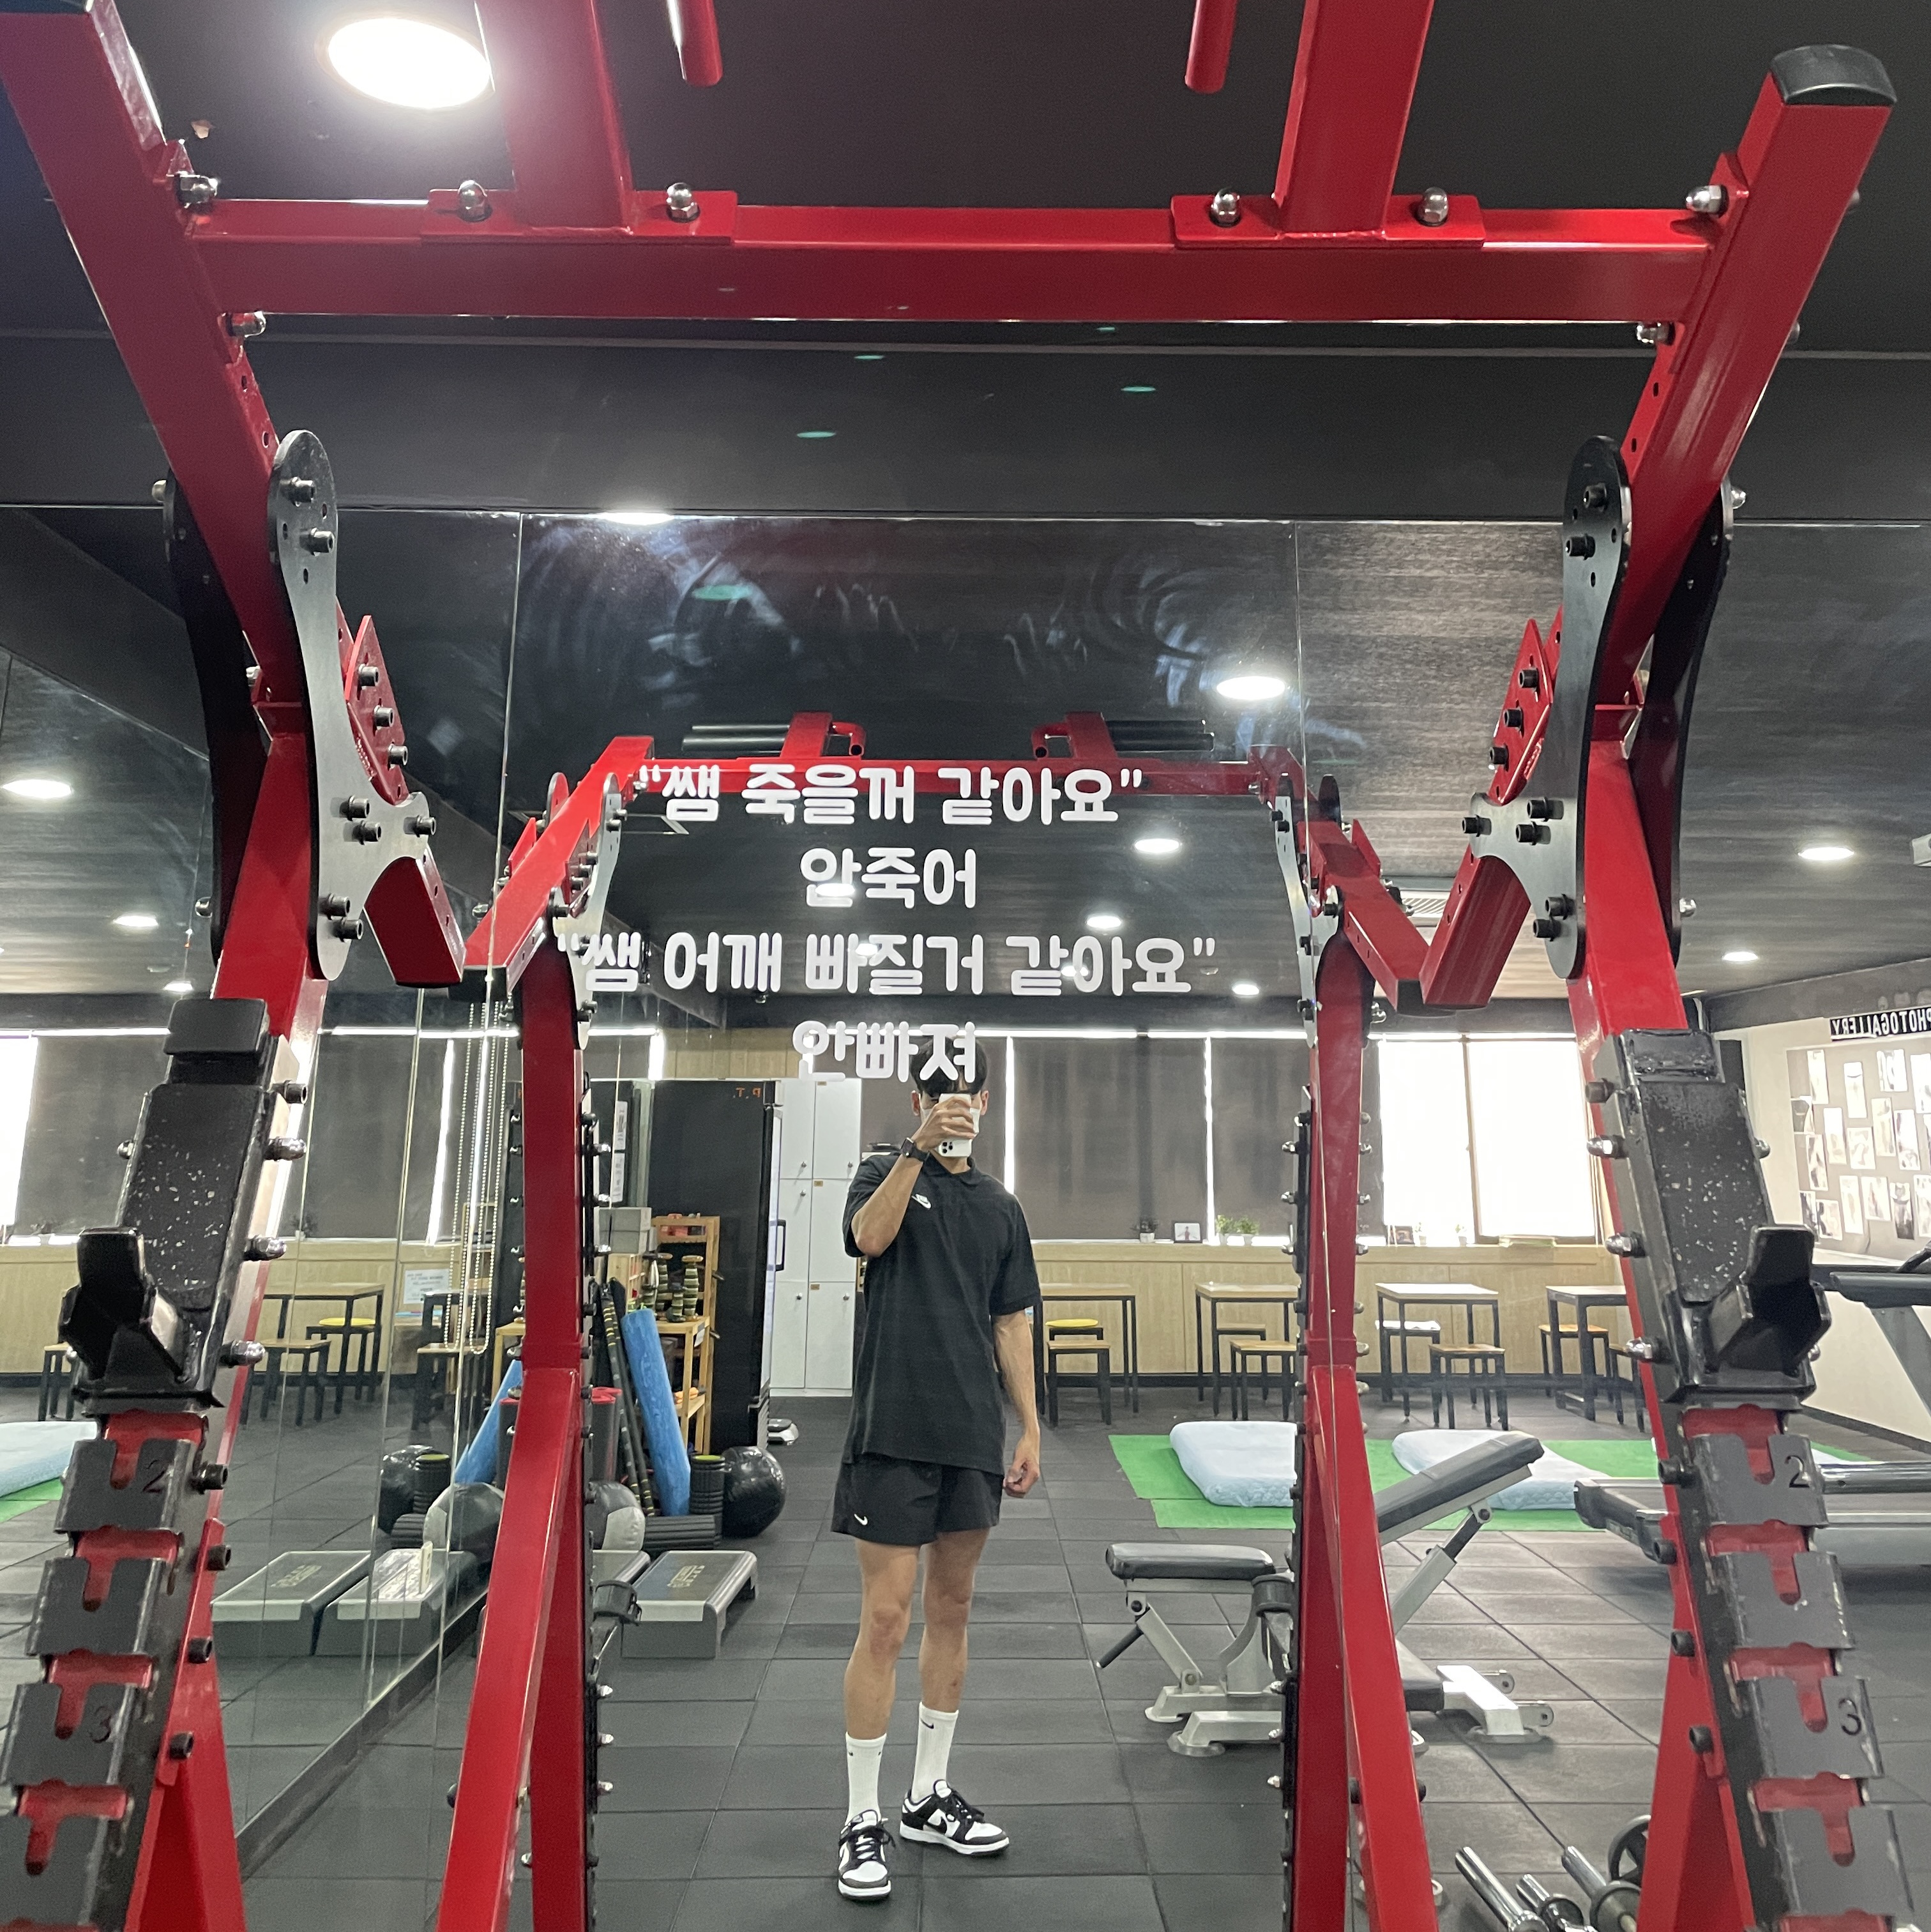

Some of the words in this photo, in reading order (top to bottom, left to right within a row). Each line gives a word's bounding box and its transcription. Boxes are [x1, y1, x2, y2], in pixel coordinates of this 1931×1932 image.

[741, 764, 914, 825] 죽을꺼
[937, 766, 1142, 825] 같아요"
[800, 848, 976, 909] 안죽어
[663, 932, 782, 993] 어깨
[805, 933, 984, 994] 빠질거
[1005, 935, 1215, 996] 같아요"
[792, 1021, 976, 1083] 안빠져
[142, 1459, 170, 1493] 2
[1784, 1455, 1810, 1488] 2
[90, 1705, 112, 1744] 3
[1838, 1698, 1862, 1736] 3
